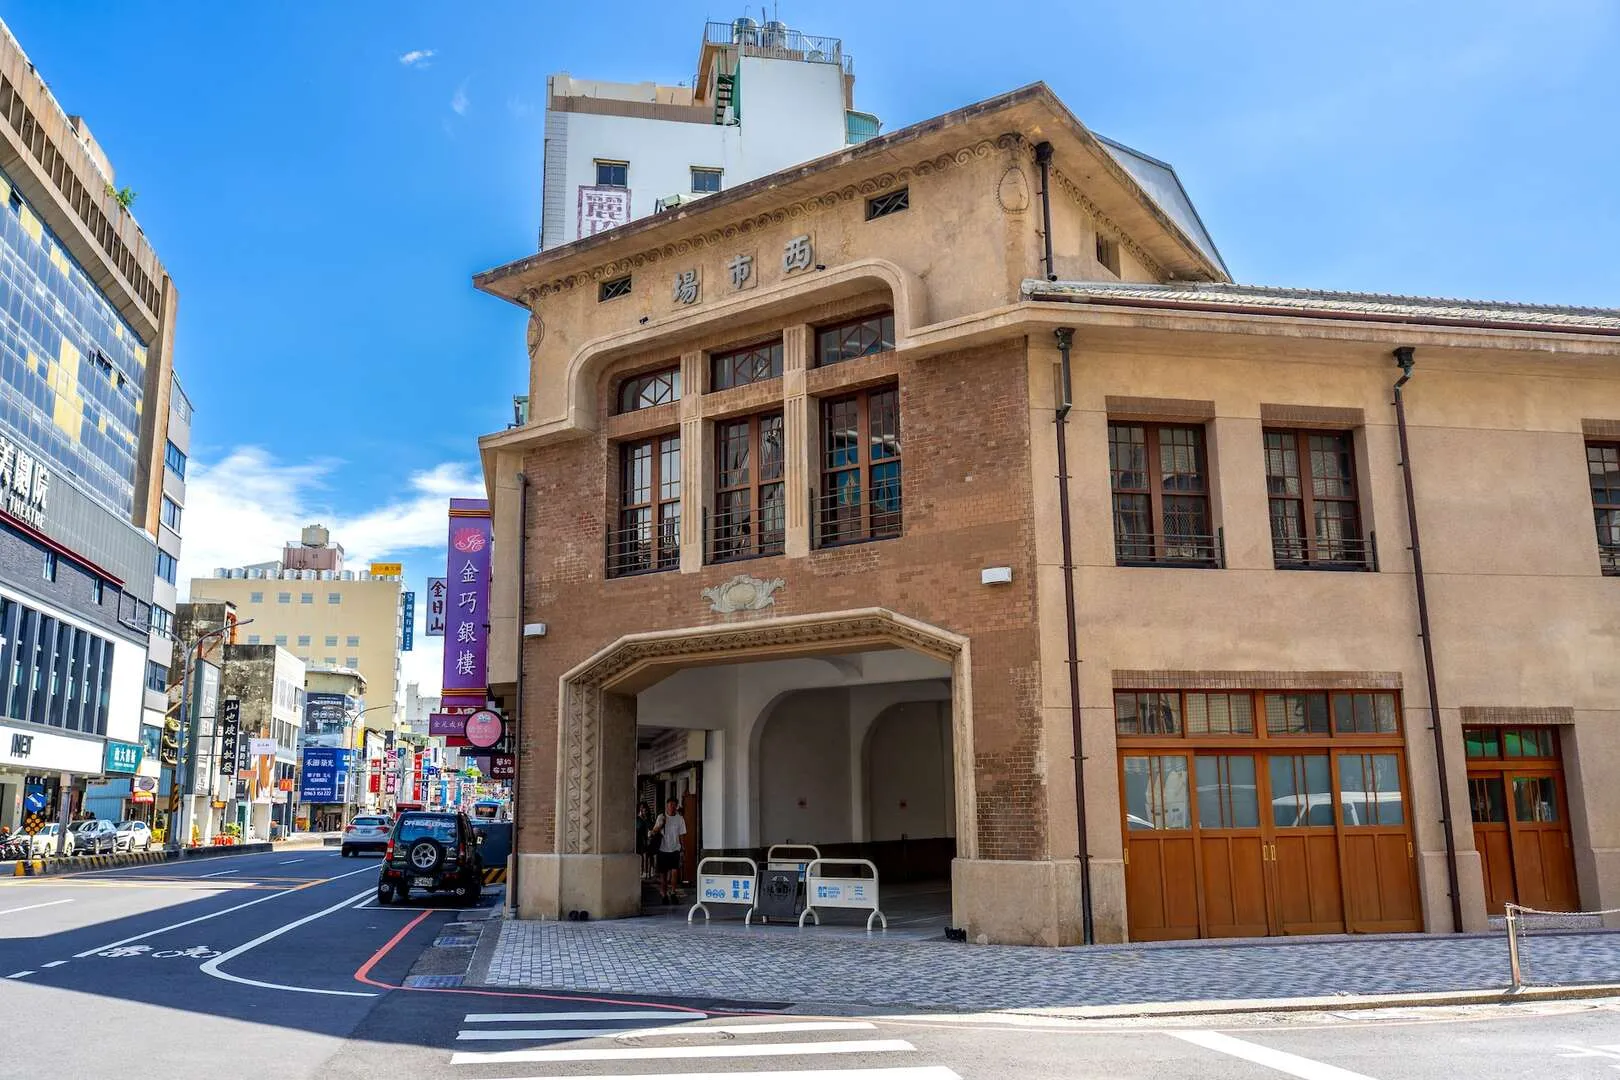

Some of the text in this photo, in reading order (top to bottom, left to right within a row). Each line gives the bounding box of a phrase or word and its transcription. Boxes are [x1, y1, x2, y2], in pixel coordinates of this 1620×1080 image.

[456, 559, 479, 676] 金巧銀樓
[12, 733, 34, 755] NET
